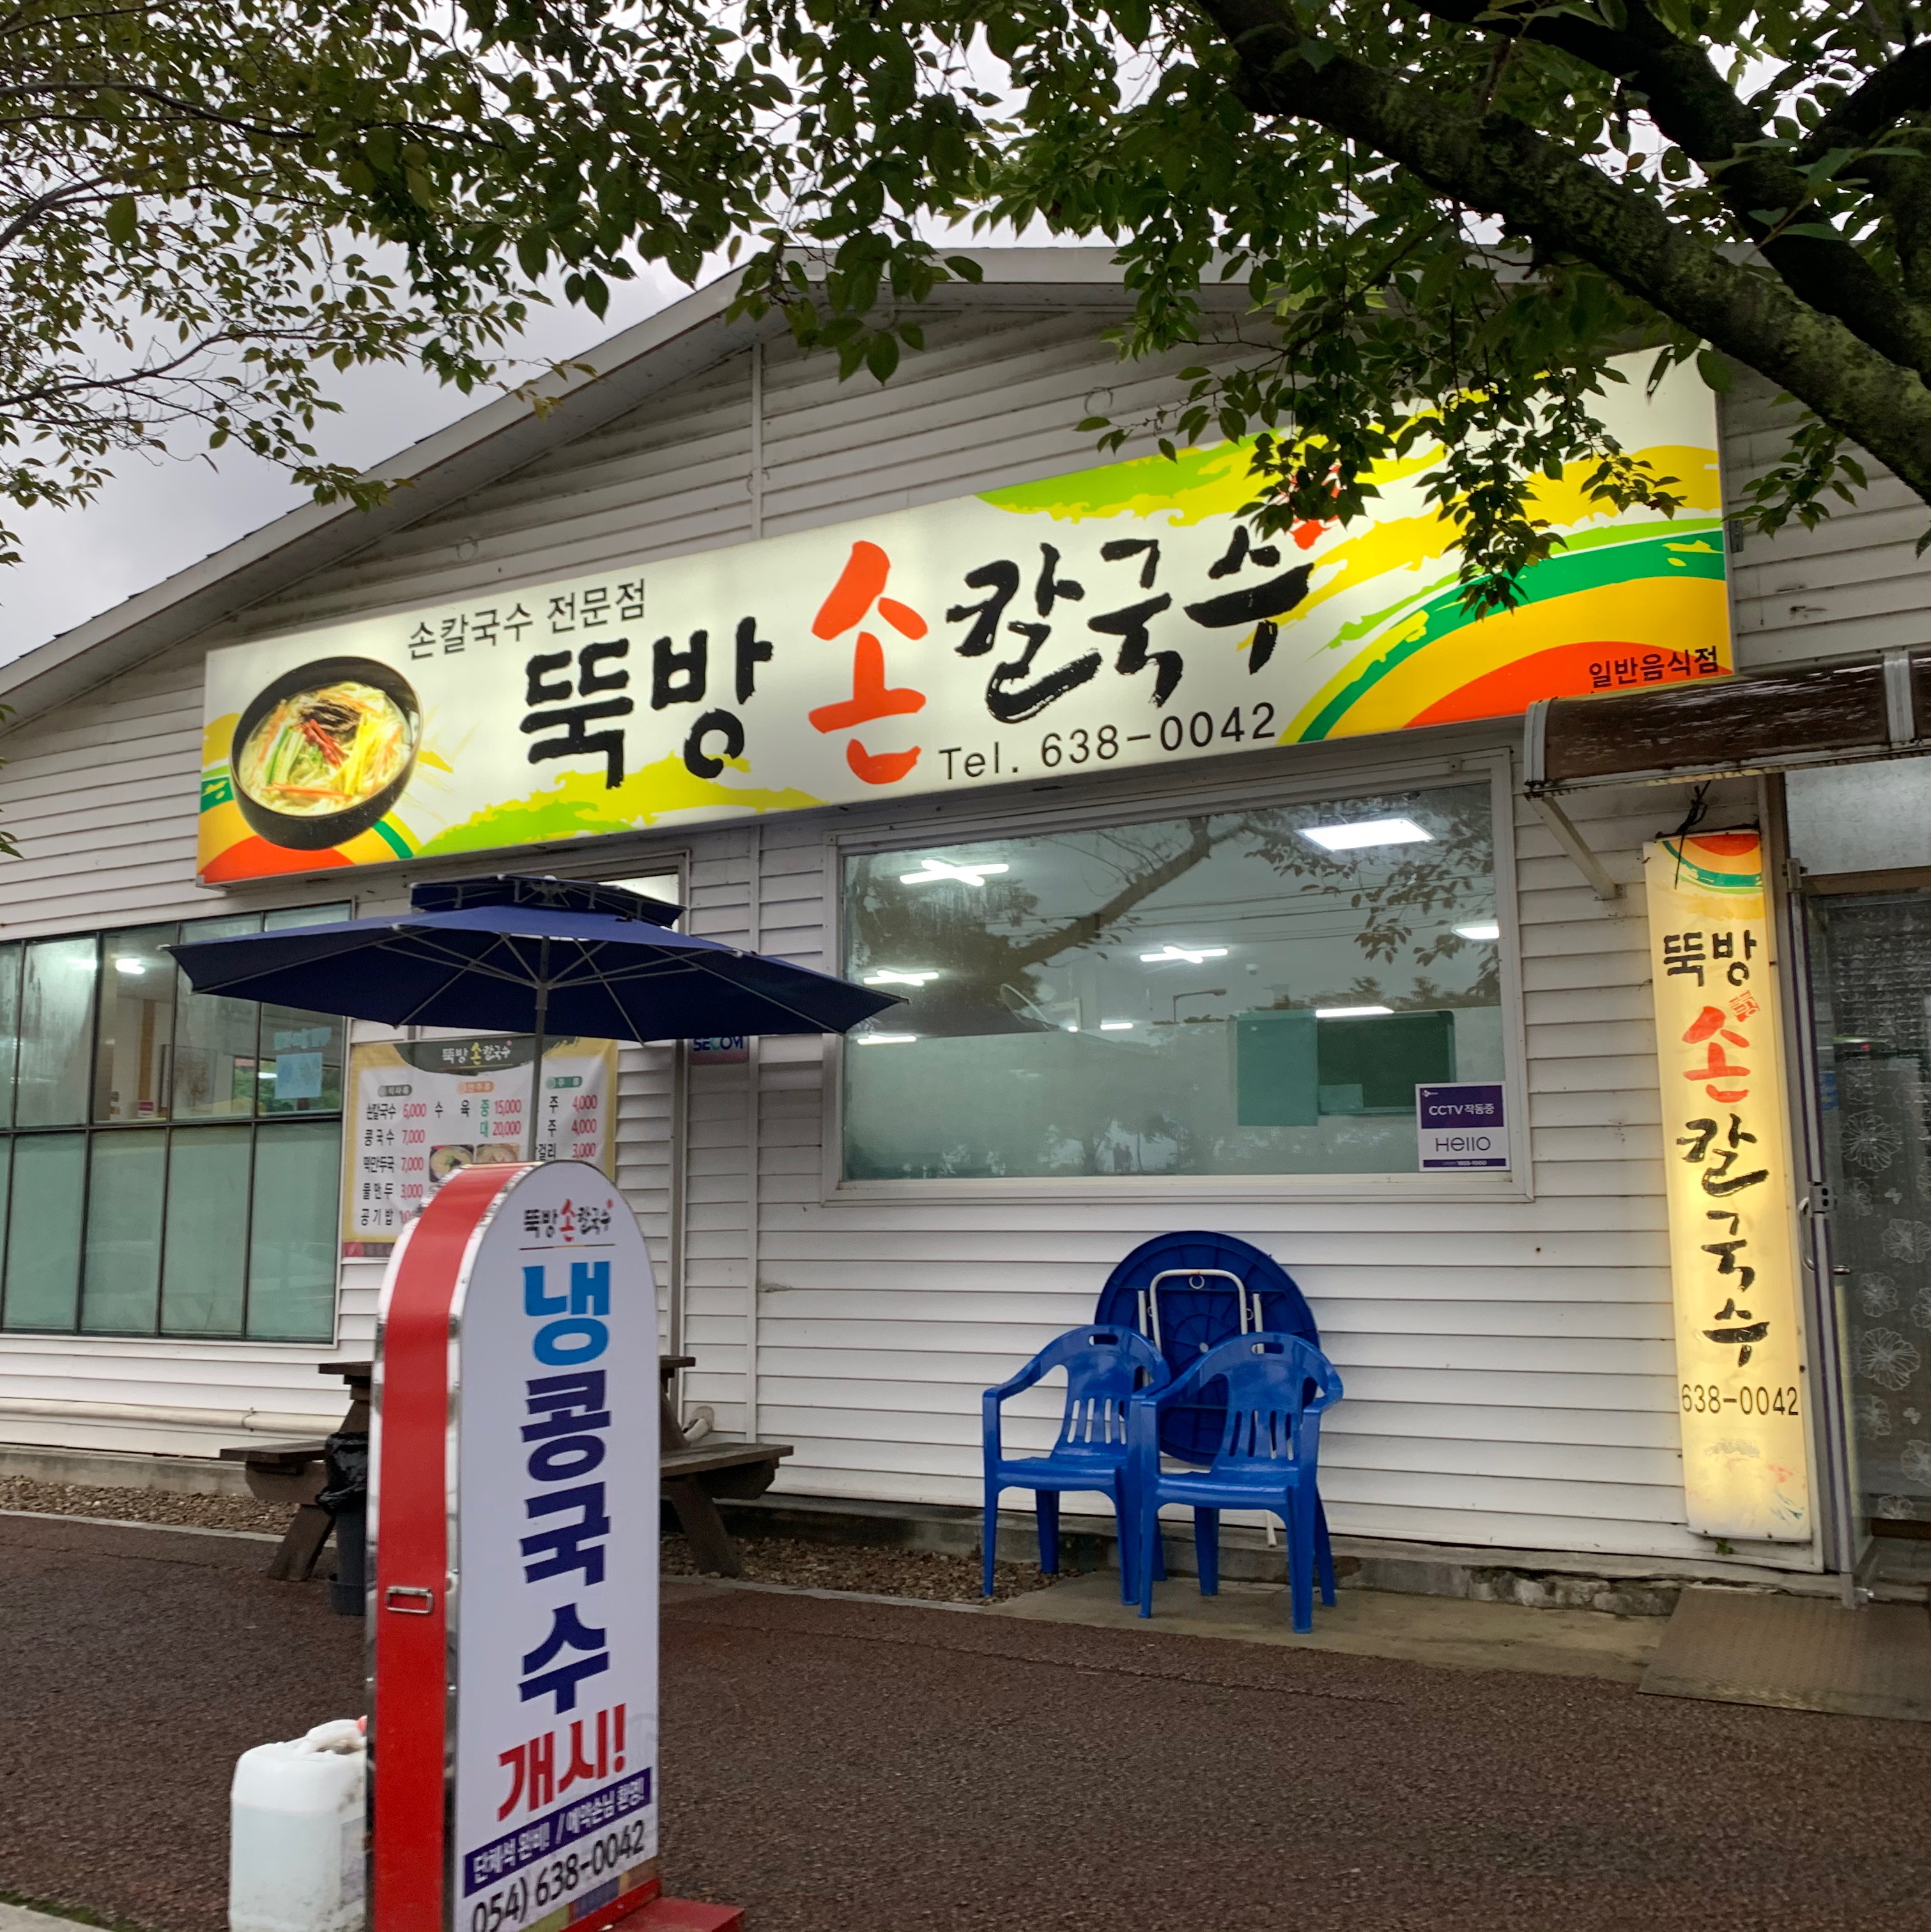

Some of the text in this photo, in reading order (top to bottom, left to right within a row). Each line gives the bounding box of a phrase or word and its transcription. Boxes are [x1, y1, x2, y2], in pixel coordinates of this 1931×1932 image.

[407, 578, 647, 661] 손칼국수 전문점
[519, 524, 1314, 790] 뚝방 손칼국수
[1589, 645, 1718, 689] 일반음식점
[939, 702, 1277, 781] Tel. 638-0042
[1663, 930, 1757, 987] 뚝방
[693, 1036, 744, 1052] SECOM
[1428, 1103, 1495, 1116] CCTV 작동중
[1676, 1006, 1771, 1368] 손칼국수
[1681, 1383, 1799, 1416] 638-0042
[518, 1261, 612, 1715] 냉콩국수
[496, 1702, 627, 1822] 개시!
[535, 1818, 645, 1906] 638-0042
